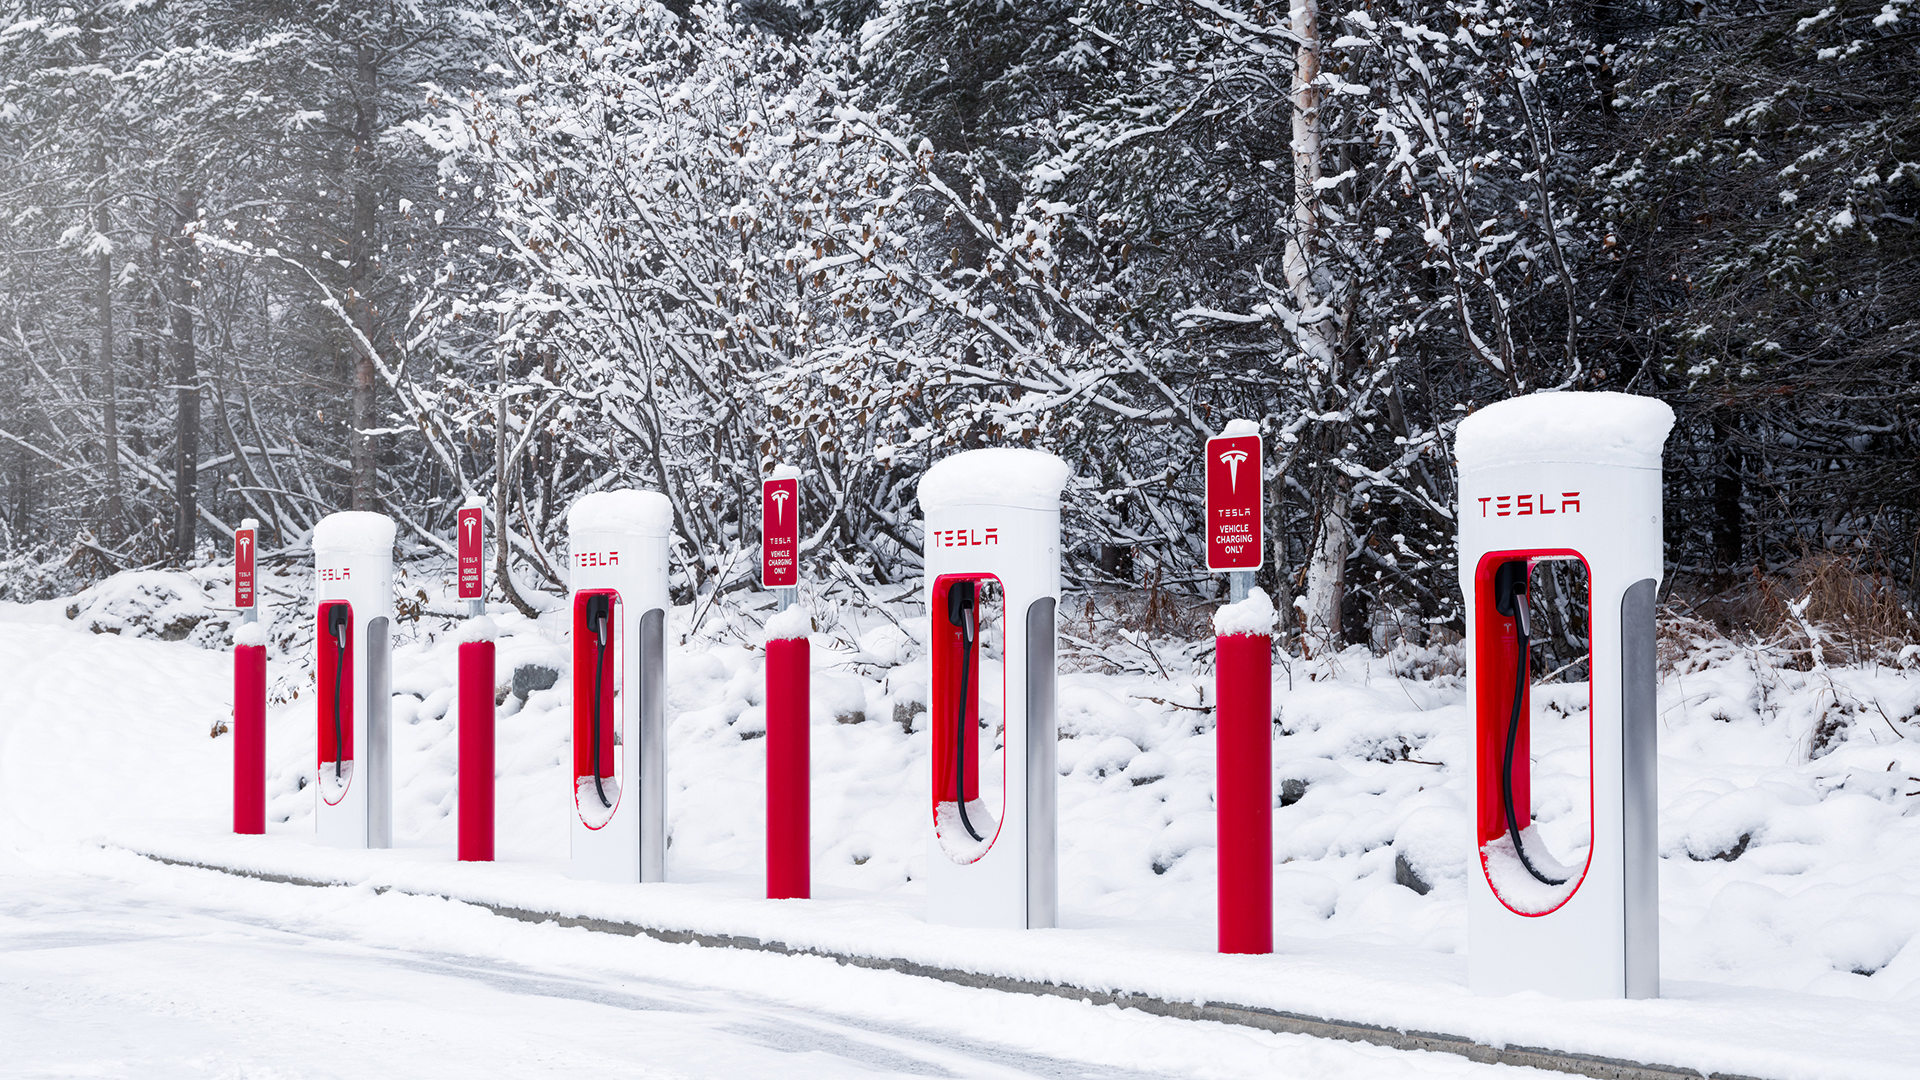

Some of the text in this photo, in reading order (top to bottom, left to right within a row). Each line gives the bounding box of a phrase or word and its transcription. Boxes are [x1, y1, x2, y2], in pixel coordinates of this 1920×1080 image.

[1477, 492, 1580, 517] TESLA
[1218, 508, 1250, 517] TESLA
[1220, 524, 1249, 533] VEHICLE
[933, 528, 998, 548] TESLA
[1216, 534, 1252, 544] CHARGING
[1225, 545, 1244, 554] ONLY
[574, 551, 618, 567] TESLA
[768, 558, 792, 566] CHARGING
[318, 568, 350, 581] TESLA
